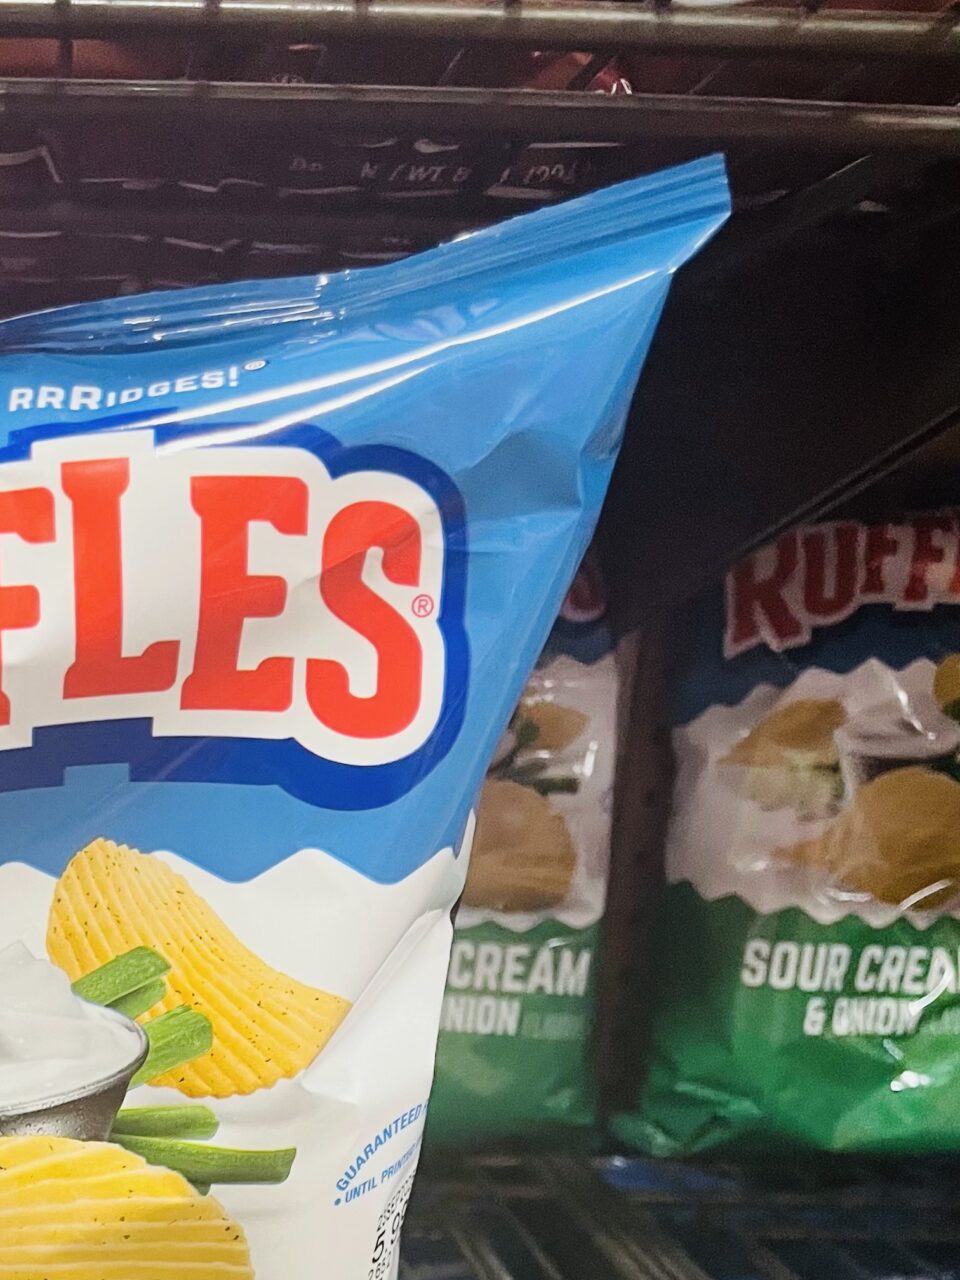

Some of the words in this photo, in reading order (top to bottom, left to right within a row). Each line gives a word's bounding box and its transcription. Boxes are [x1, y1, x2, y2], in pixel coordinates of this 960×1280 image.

[726, 512, 960, 656] RUFF
[448, 939, 592, 997] CREAM
[741, 938, 852, 992] SOUR
[854, 944, 960, 995] CREA
[441, 995, 521, 1036] NION
[832, 997, 924, 1036] ONION
[336, 1104, 422, 1191] GUARANTEED
[345, 1177, 378, 1203] UNTIL
